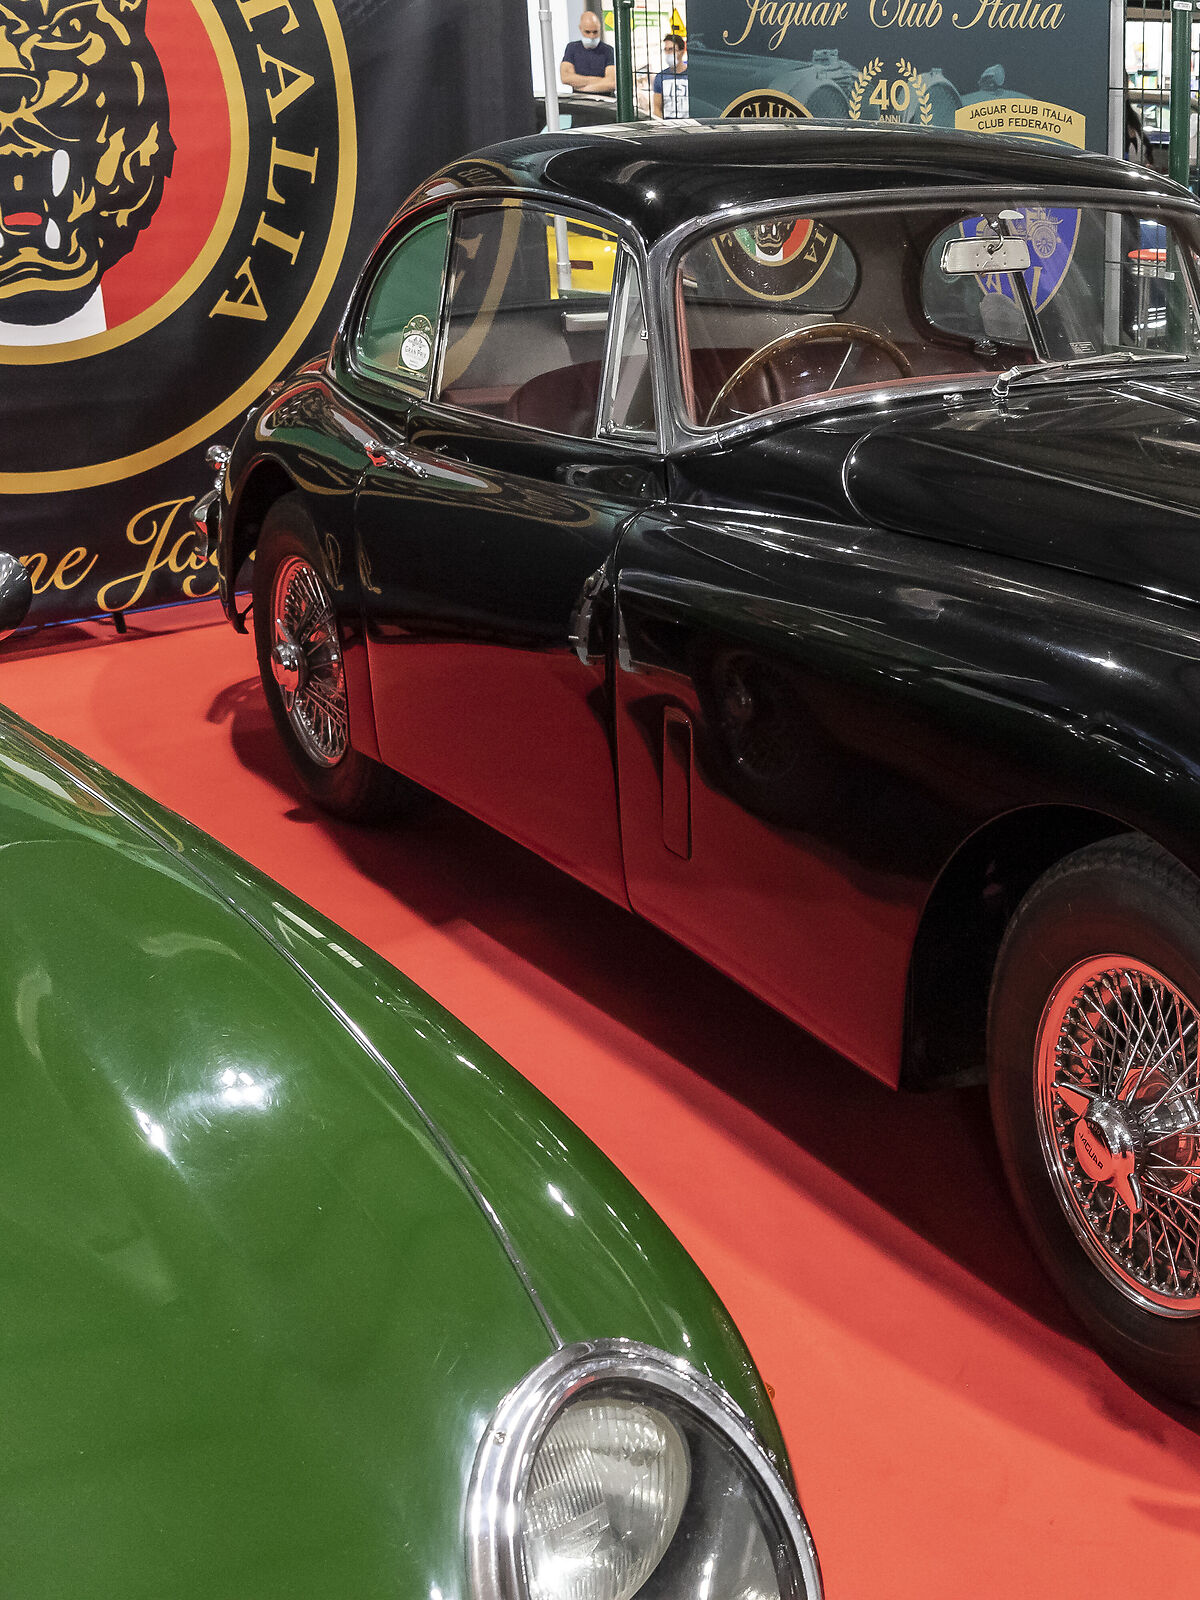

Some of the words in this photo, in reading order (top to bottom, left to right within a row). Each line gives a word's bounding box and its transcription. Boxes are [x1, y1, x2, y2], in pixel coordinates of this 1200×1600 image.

[723, 0, 848, 50] Jaguar
[869, 0, 943, 28] Club
[952, 0, 1066, 29] Italia
[868, 79, 911, 111] 40
[879, 115, 900, 123] ANNI
[970, 105, 1007, 119] JAGUAR
[1011, 105, 1038, 114] CLUB
[1042, 107, 1073, 125] ITALIA
[978, 118, 1004, 130] CLUB
[1008, 118, 1061, 134] FEDERATO
